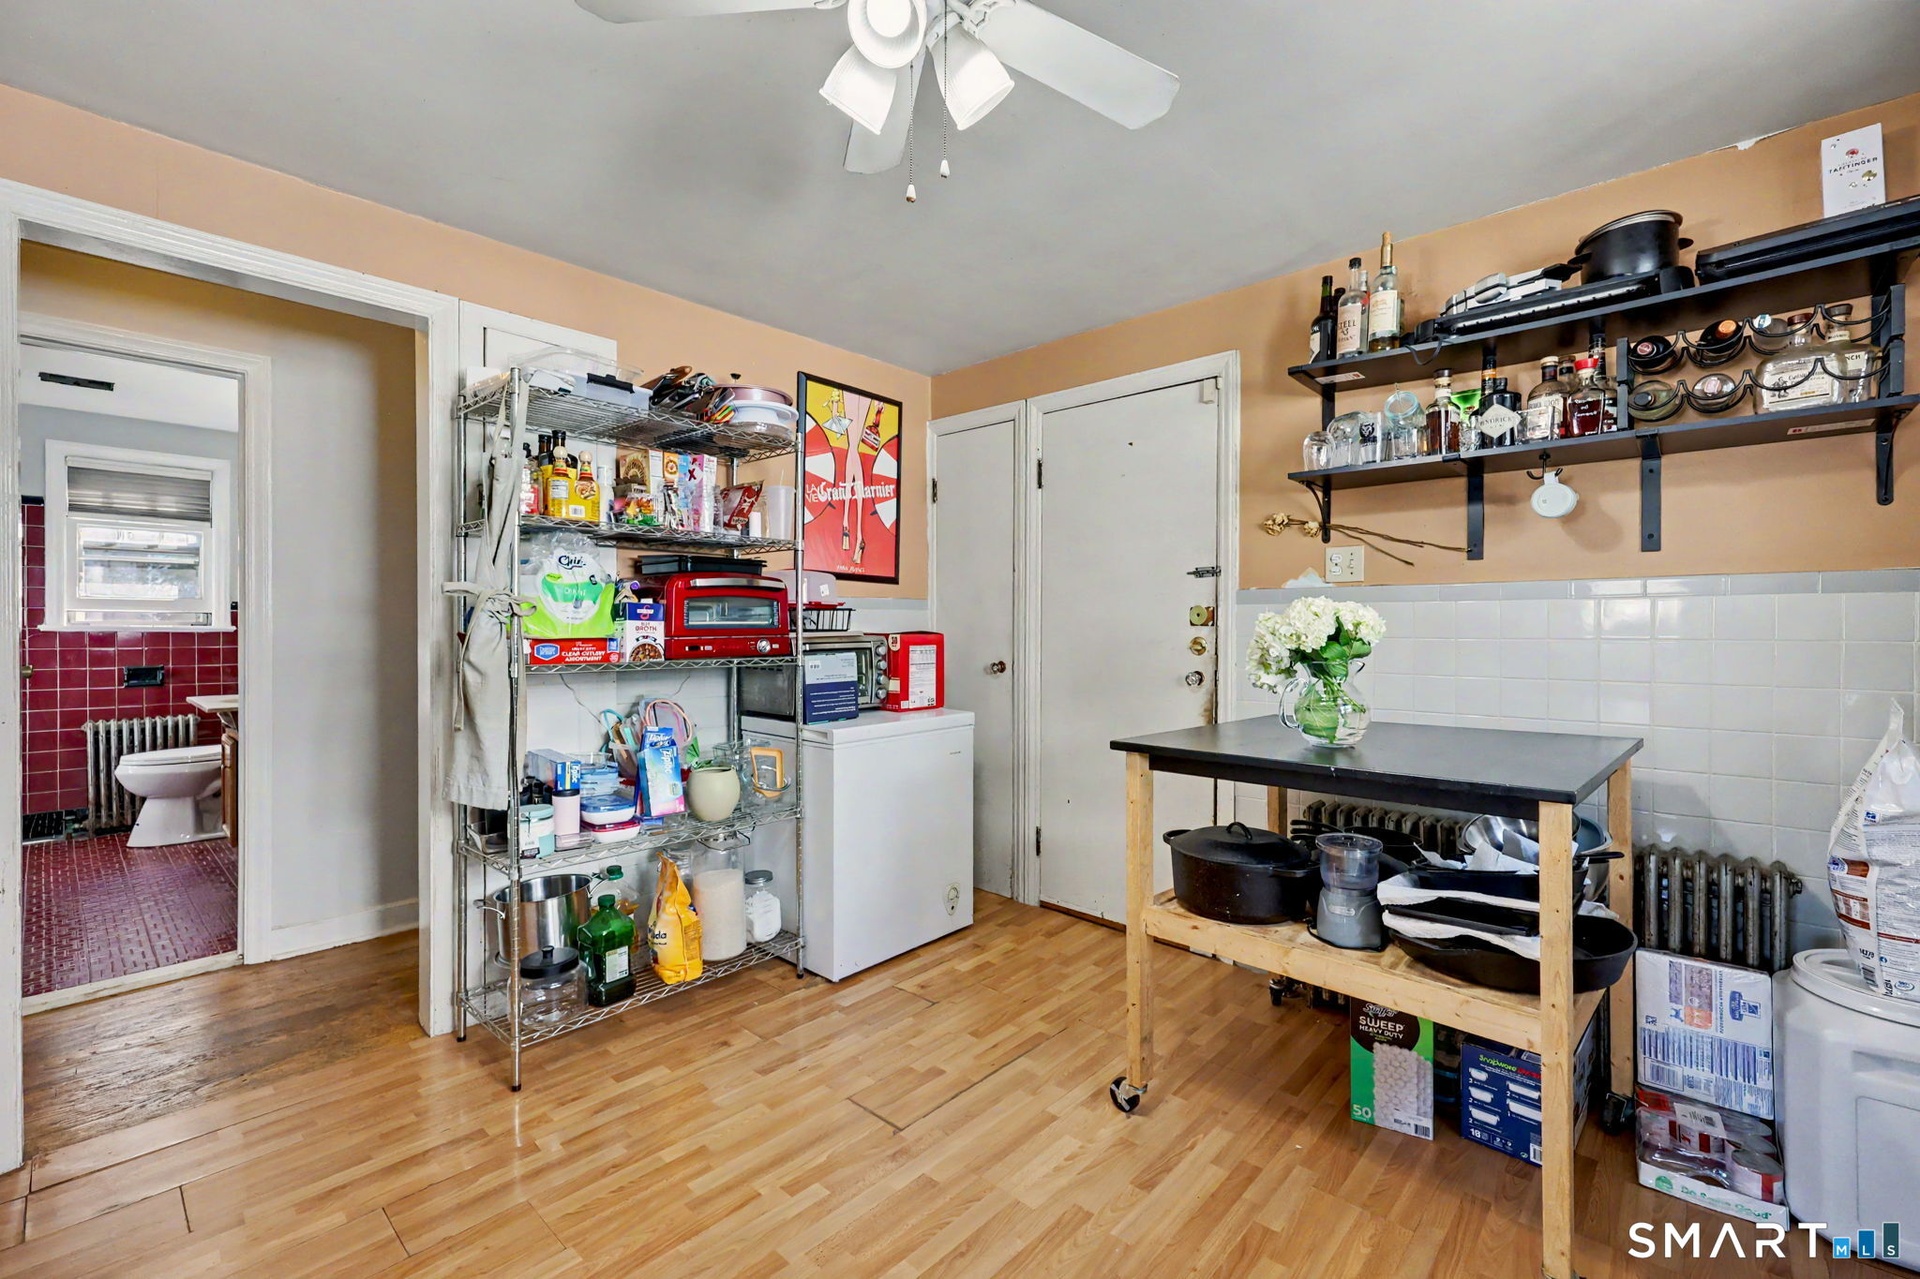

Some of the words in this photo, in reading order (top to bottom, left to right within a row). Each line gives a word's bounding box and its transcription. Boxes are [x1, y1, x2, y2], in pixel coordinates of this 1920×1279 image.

[1359, 1016, 1405, 1033] SWEEP
[1359, 1025, 1384, 1034] HEAVY
[1383, 1030, 1404, 1040] DUTY
[1352, 1103, 1372, 1119] 50
[1469, 1128, 1481, 1139] 18
